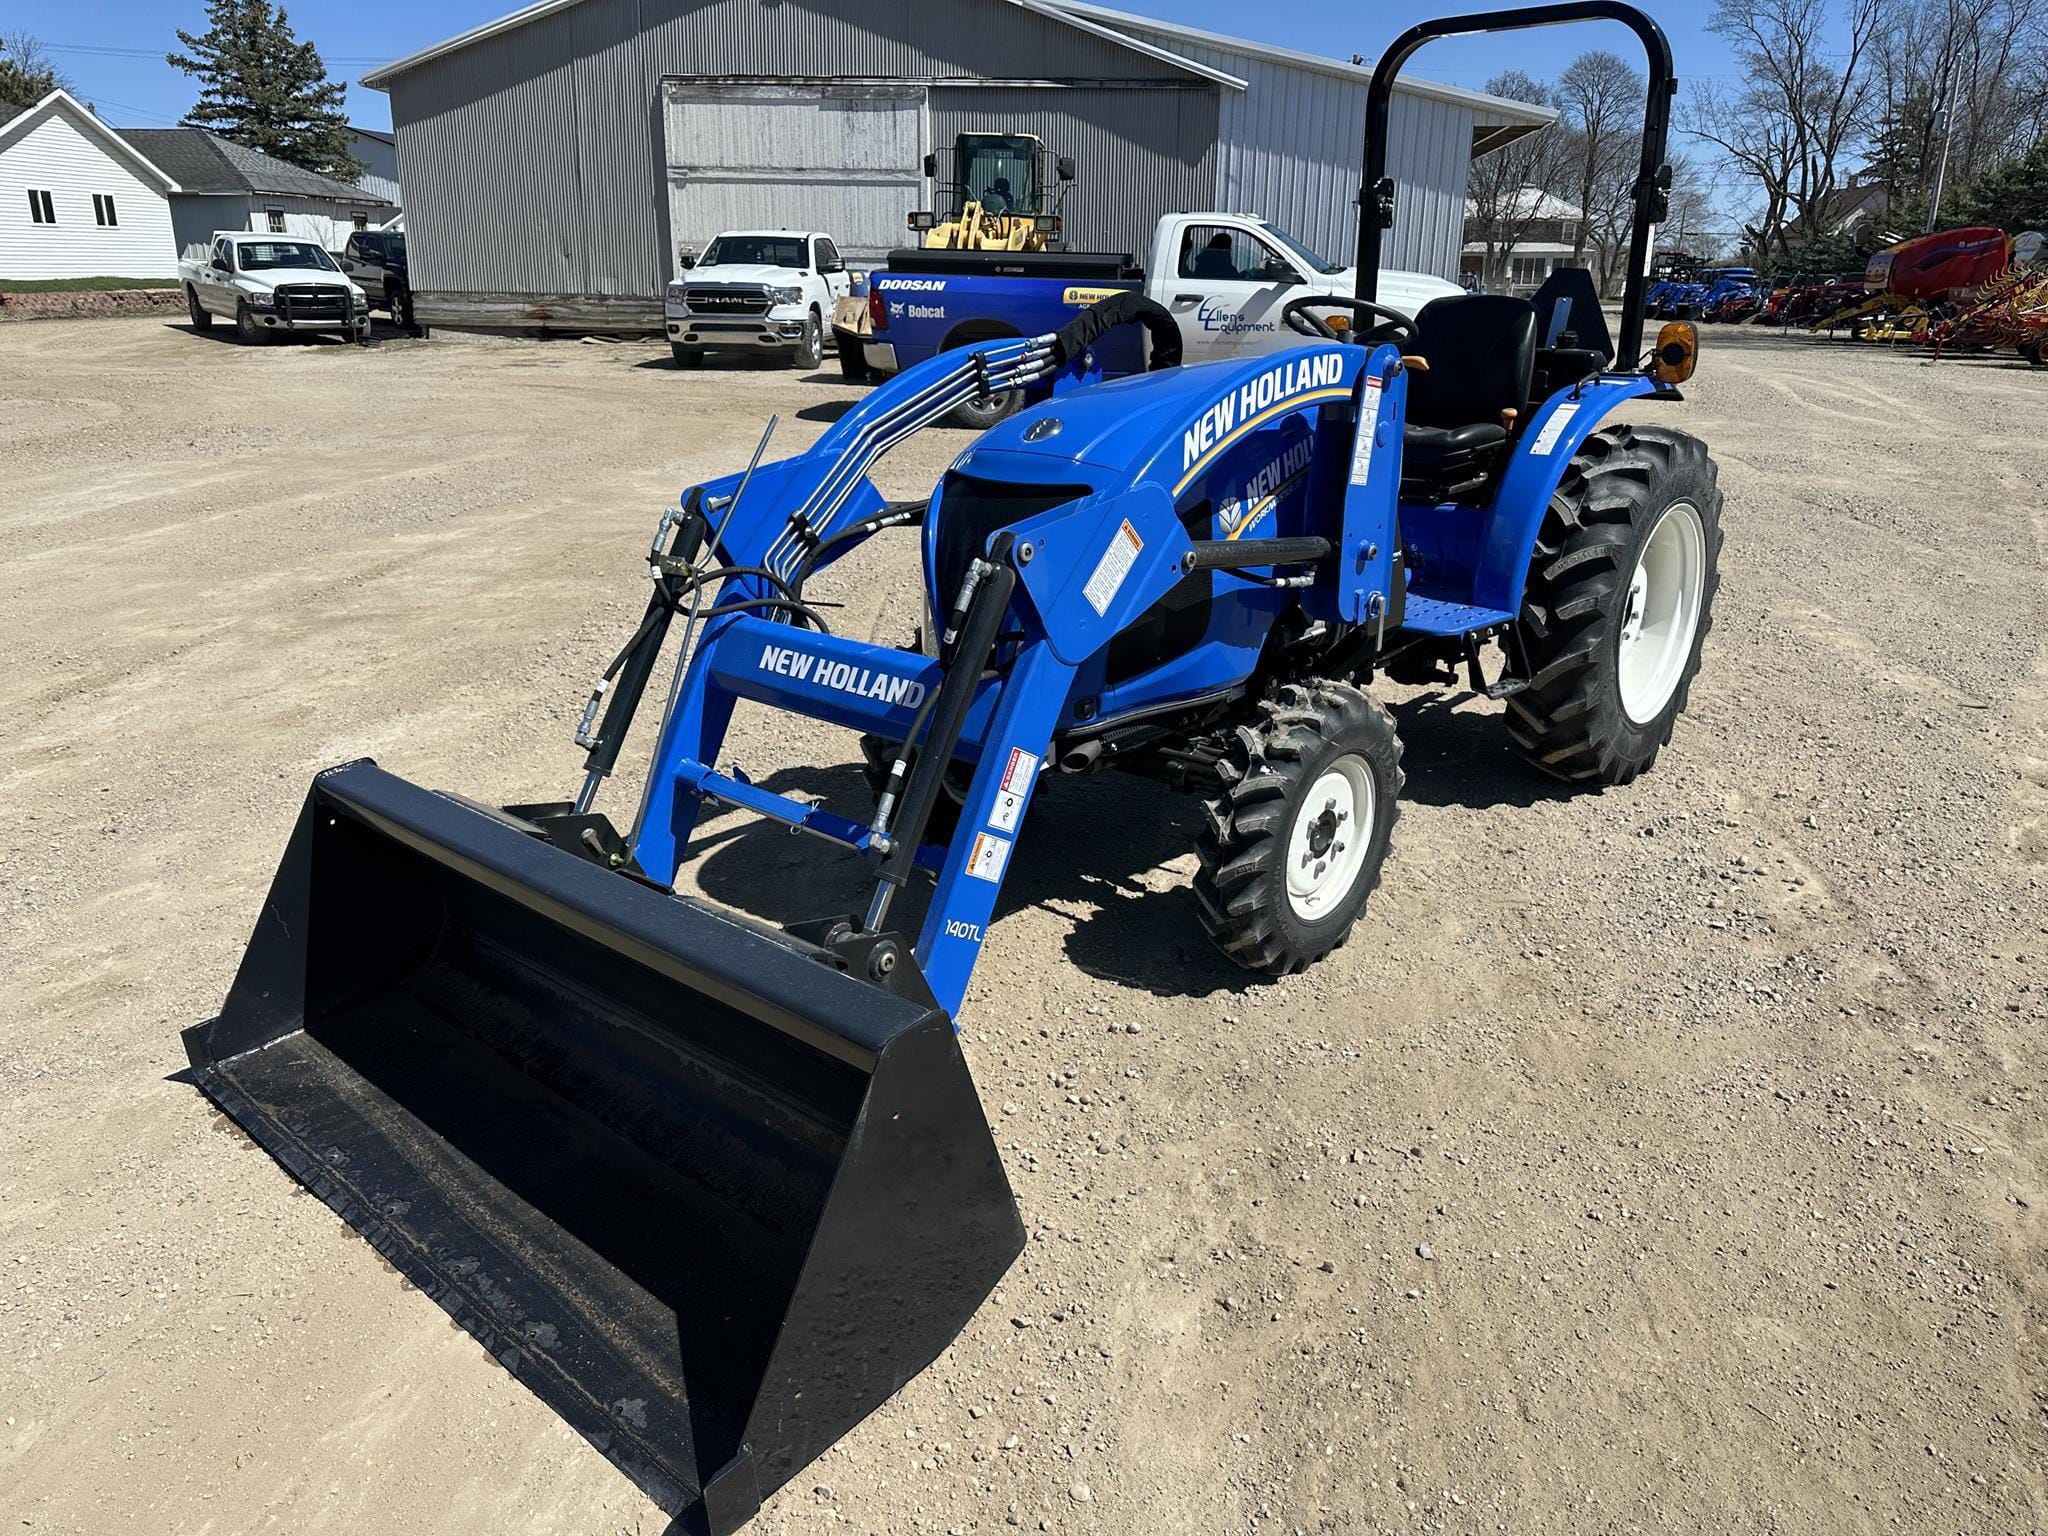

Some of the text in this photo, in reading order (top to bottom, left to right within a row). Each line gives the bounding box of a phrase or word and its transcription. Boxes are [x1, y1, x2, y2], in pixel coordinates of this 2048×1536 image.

[878, 279, 946, 291] DOOSAN
[908, 304, 945, 318] Bobcat
[1198, 295, 1245, 322] Ellens
[1204, 304, 1276, 335] Equipment
[1183, 353, 1344, 472] NEW HOLLAND
[1246, 456, 1281, 511] NEW
[759, 645, 926, 709] NEW HOLLAND
[1004, 751, 1019, 783] DANGER
[945, 919, 982, 942] 140TL
